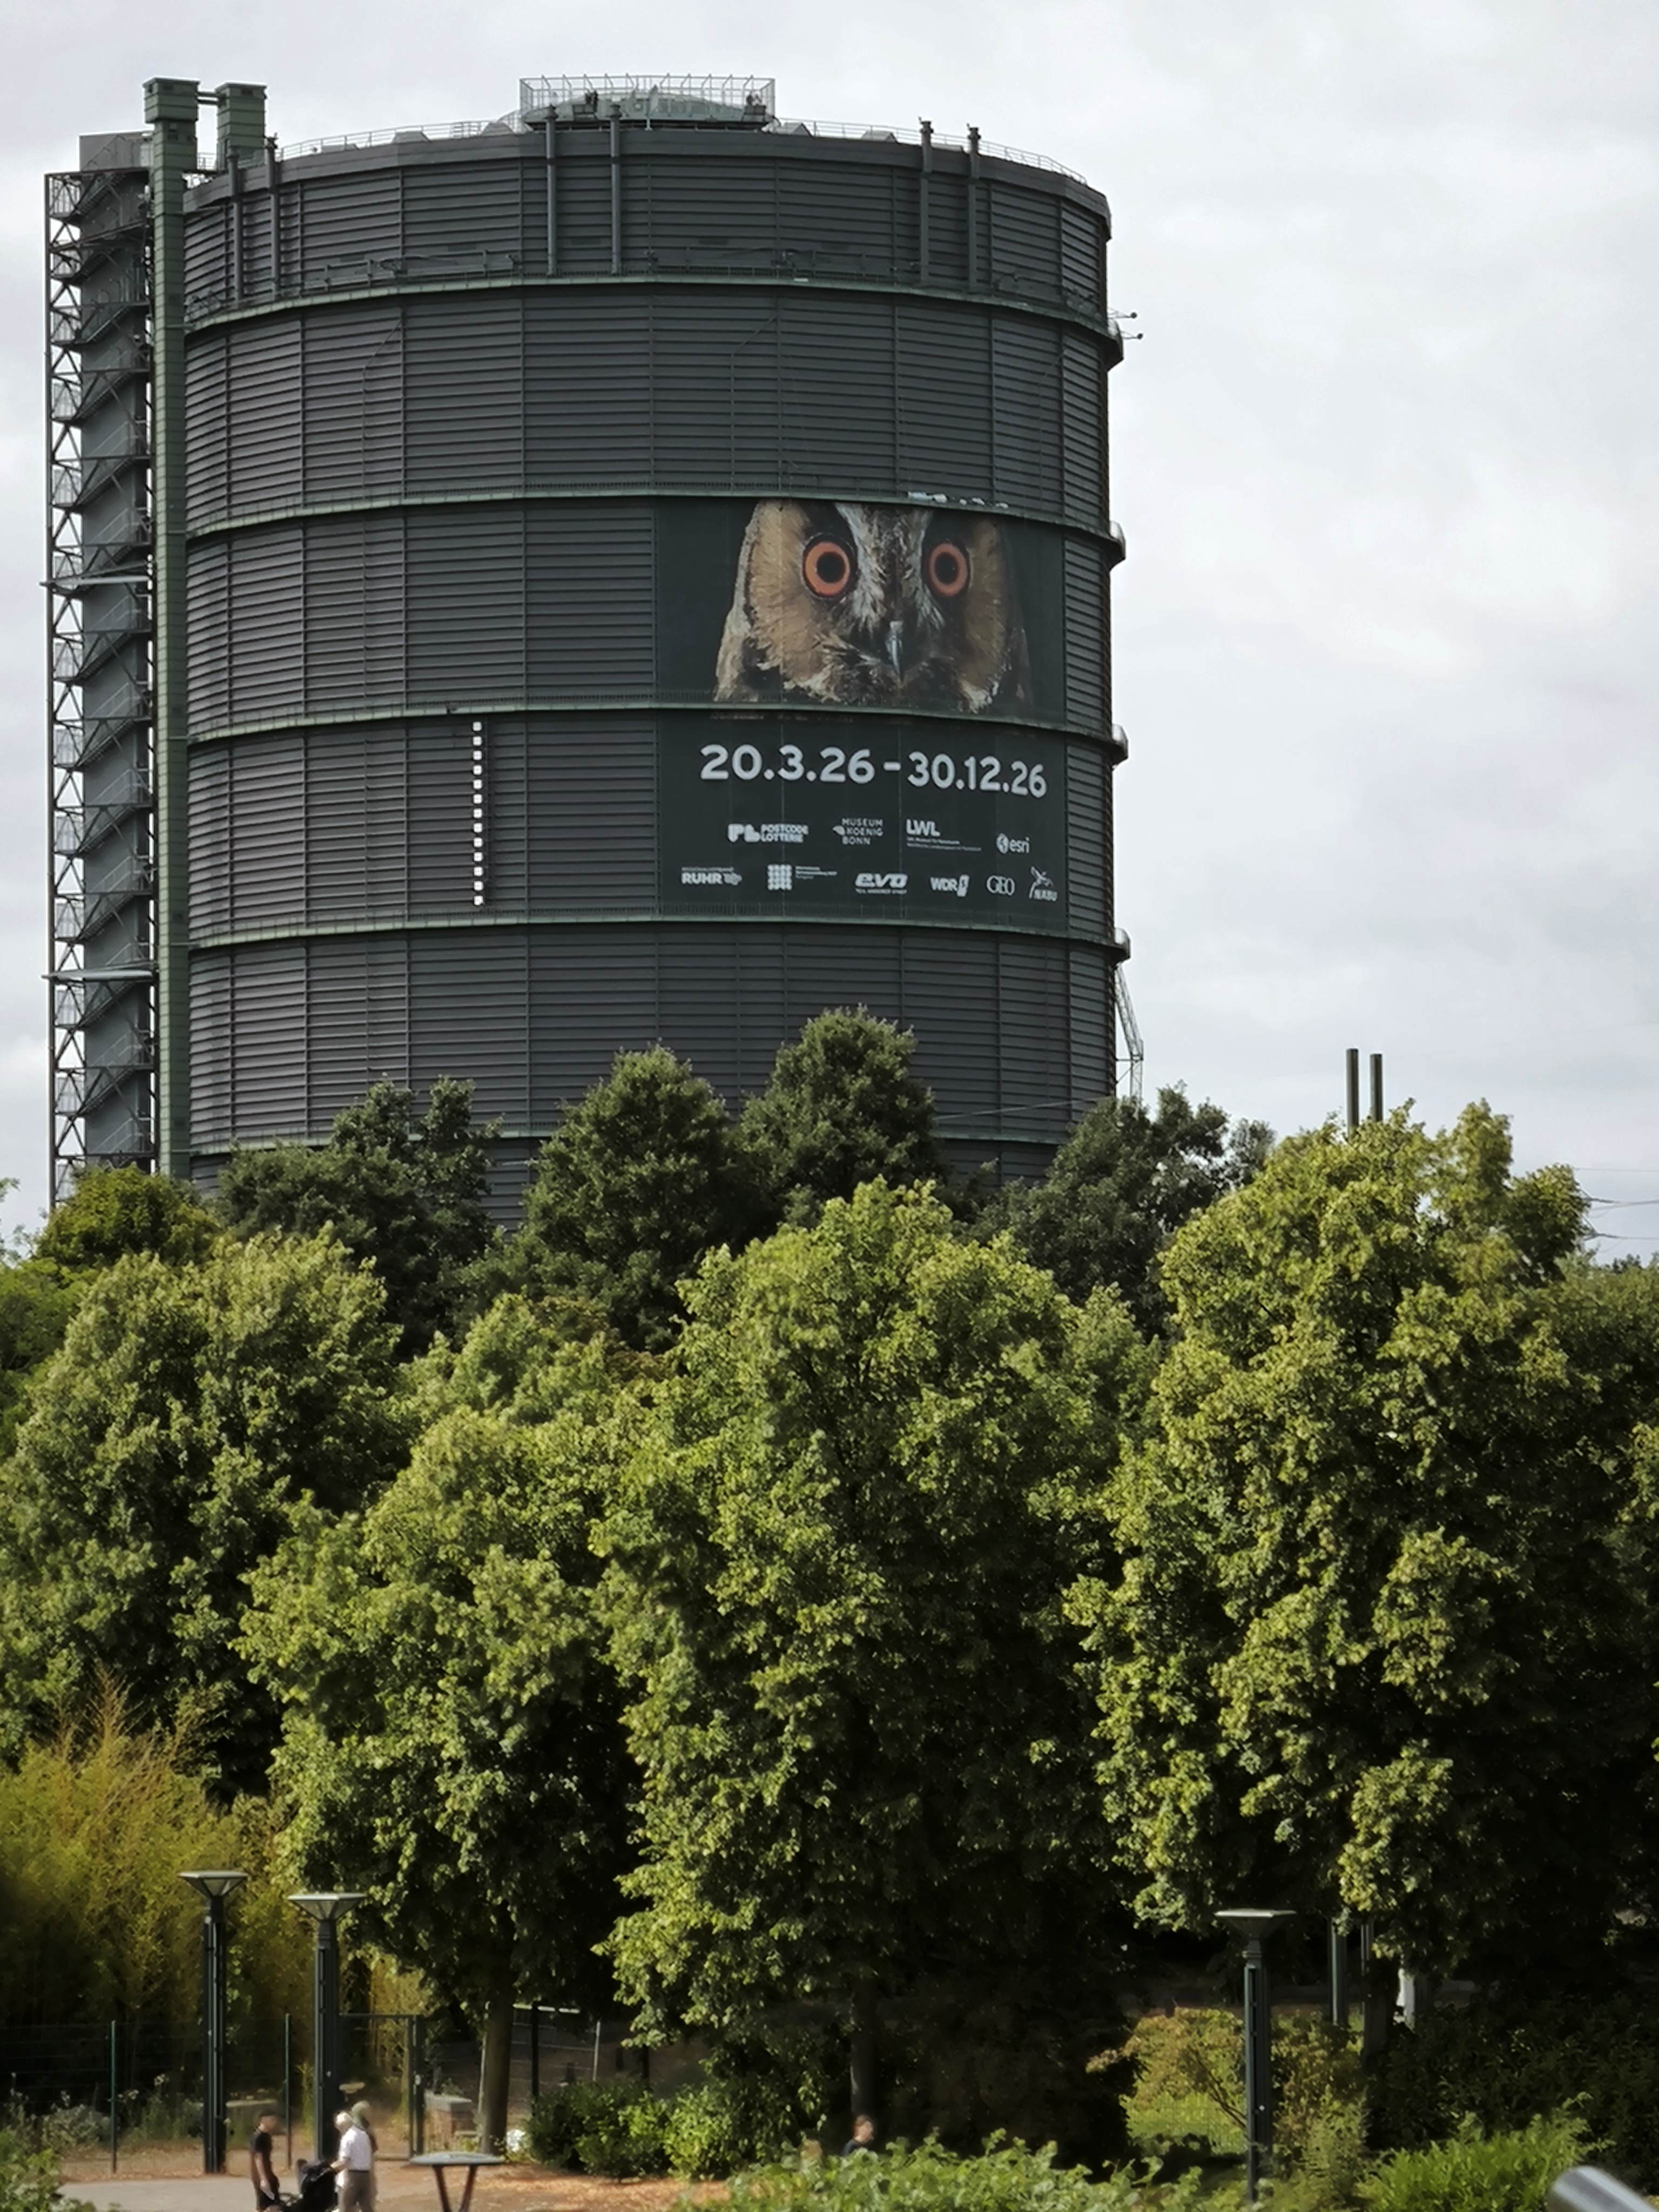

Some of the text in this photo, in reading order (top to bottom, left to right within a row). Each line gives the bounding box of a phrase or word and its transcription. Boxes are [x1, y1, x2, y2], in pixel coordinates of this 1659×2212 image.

[700, 744, 875, 784] 20.3.26
[907, 751, 1047, 798] 30.12.26
[842, 818, 883, 827] MUSEUM
[906, 819, 941, 837] LWL
[846, 827, 883, 837] KOENIG
[842, 835, 871, 845] BONN
[1009, 837, 1030, 853] esri
[682, 872, 723, 885] RUHR
[930, 877, 958, 891] WDR
[987, 875, 1015, 895] GEO
